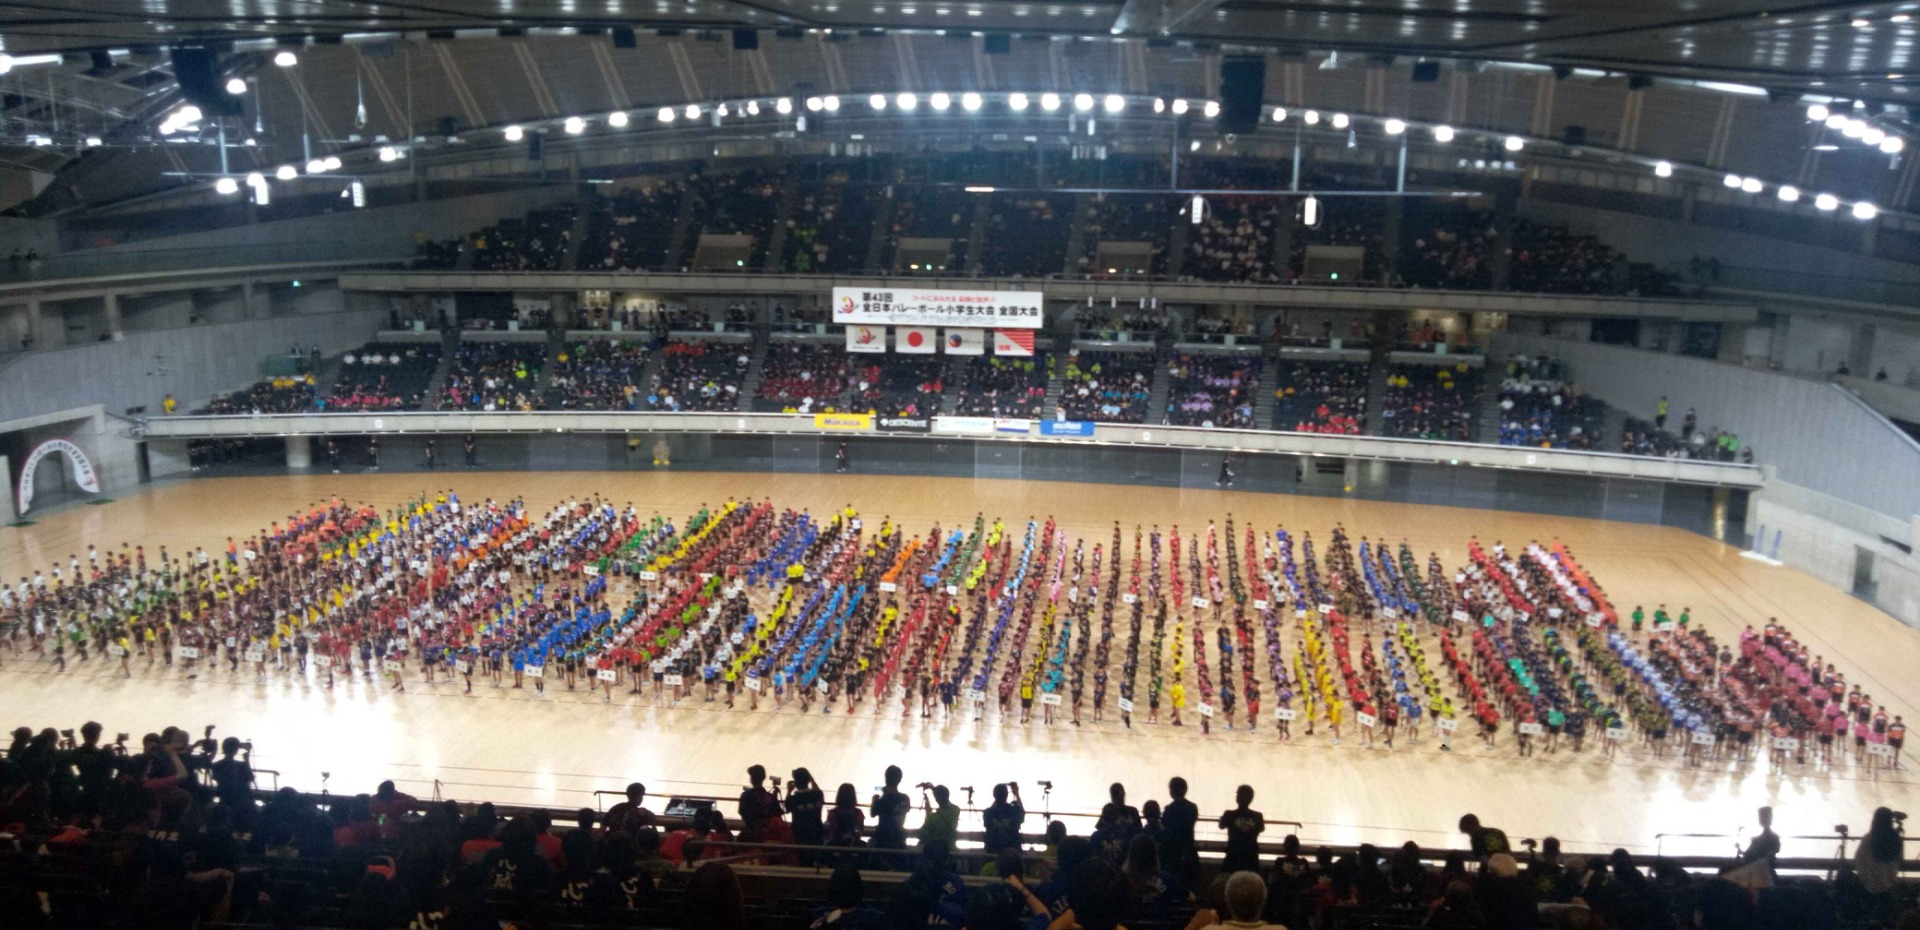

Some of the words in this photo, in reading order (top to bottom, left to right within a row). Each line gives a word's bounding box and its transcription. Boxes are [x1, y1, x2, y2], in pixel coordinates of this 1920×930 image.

[863, 292, 893, 302] 第43回
[863, 303, 995, 315] 全日本バレーボール小学生大会
[999, 306, 1038, 316] 全国大会
